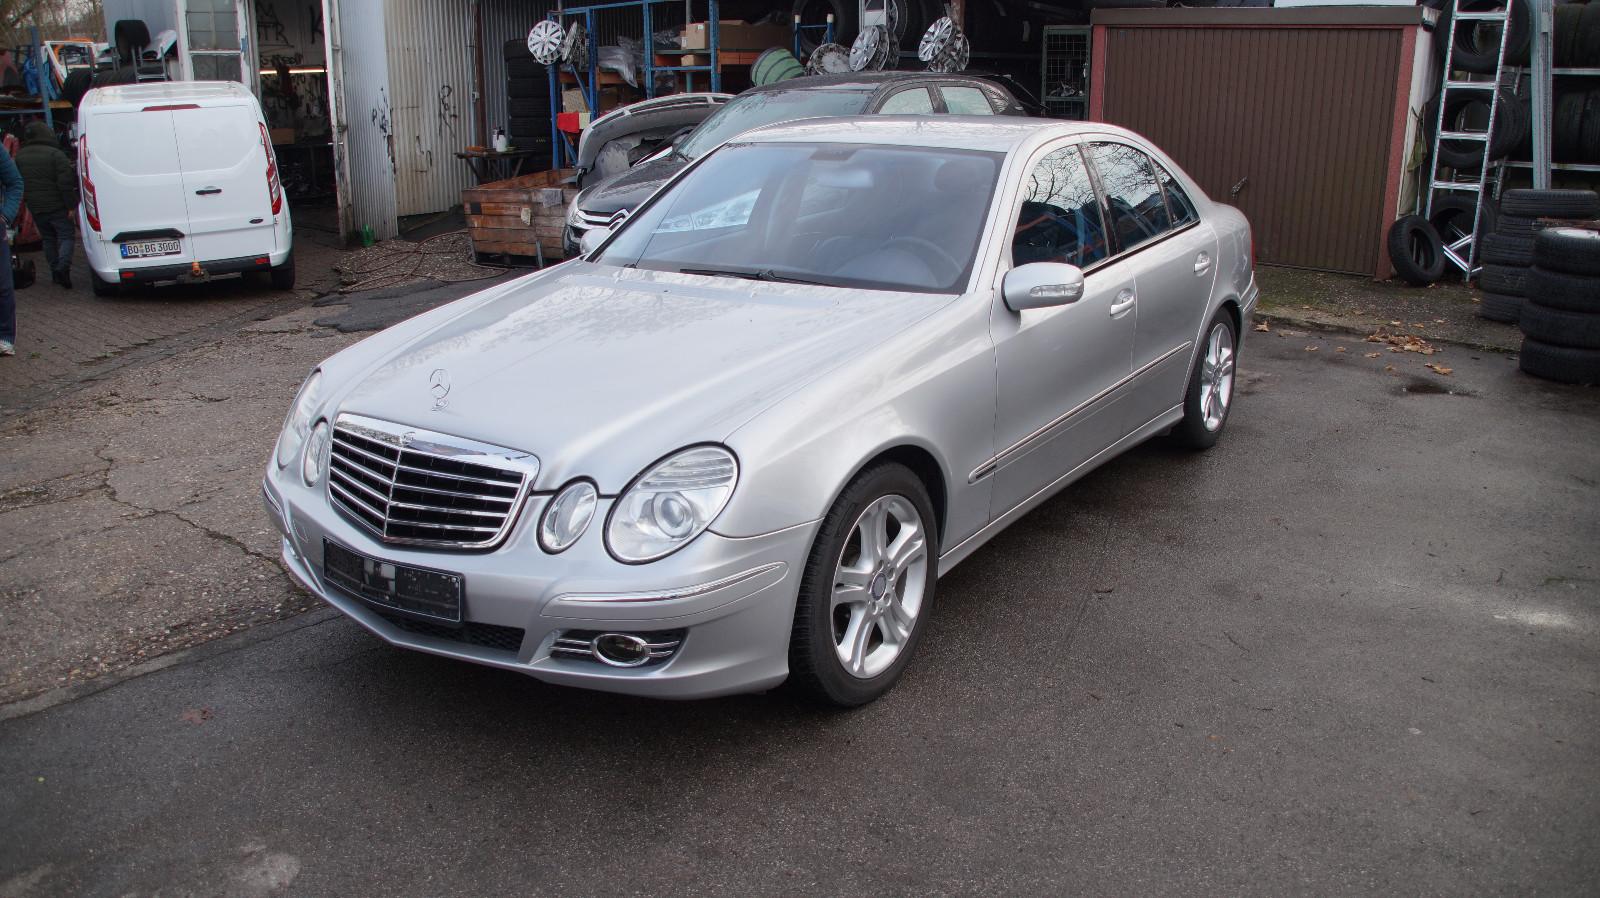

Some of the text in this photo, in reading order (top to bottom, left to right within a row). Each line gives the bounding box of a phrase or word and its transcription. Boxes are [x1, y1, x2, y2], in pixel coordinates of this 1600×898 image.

[128, 242, 178, 254] BO BG 3000
